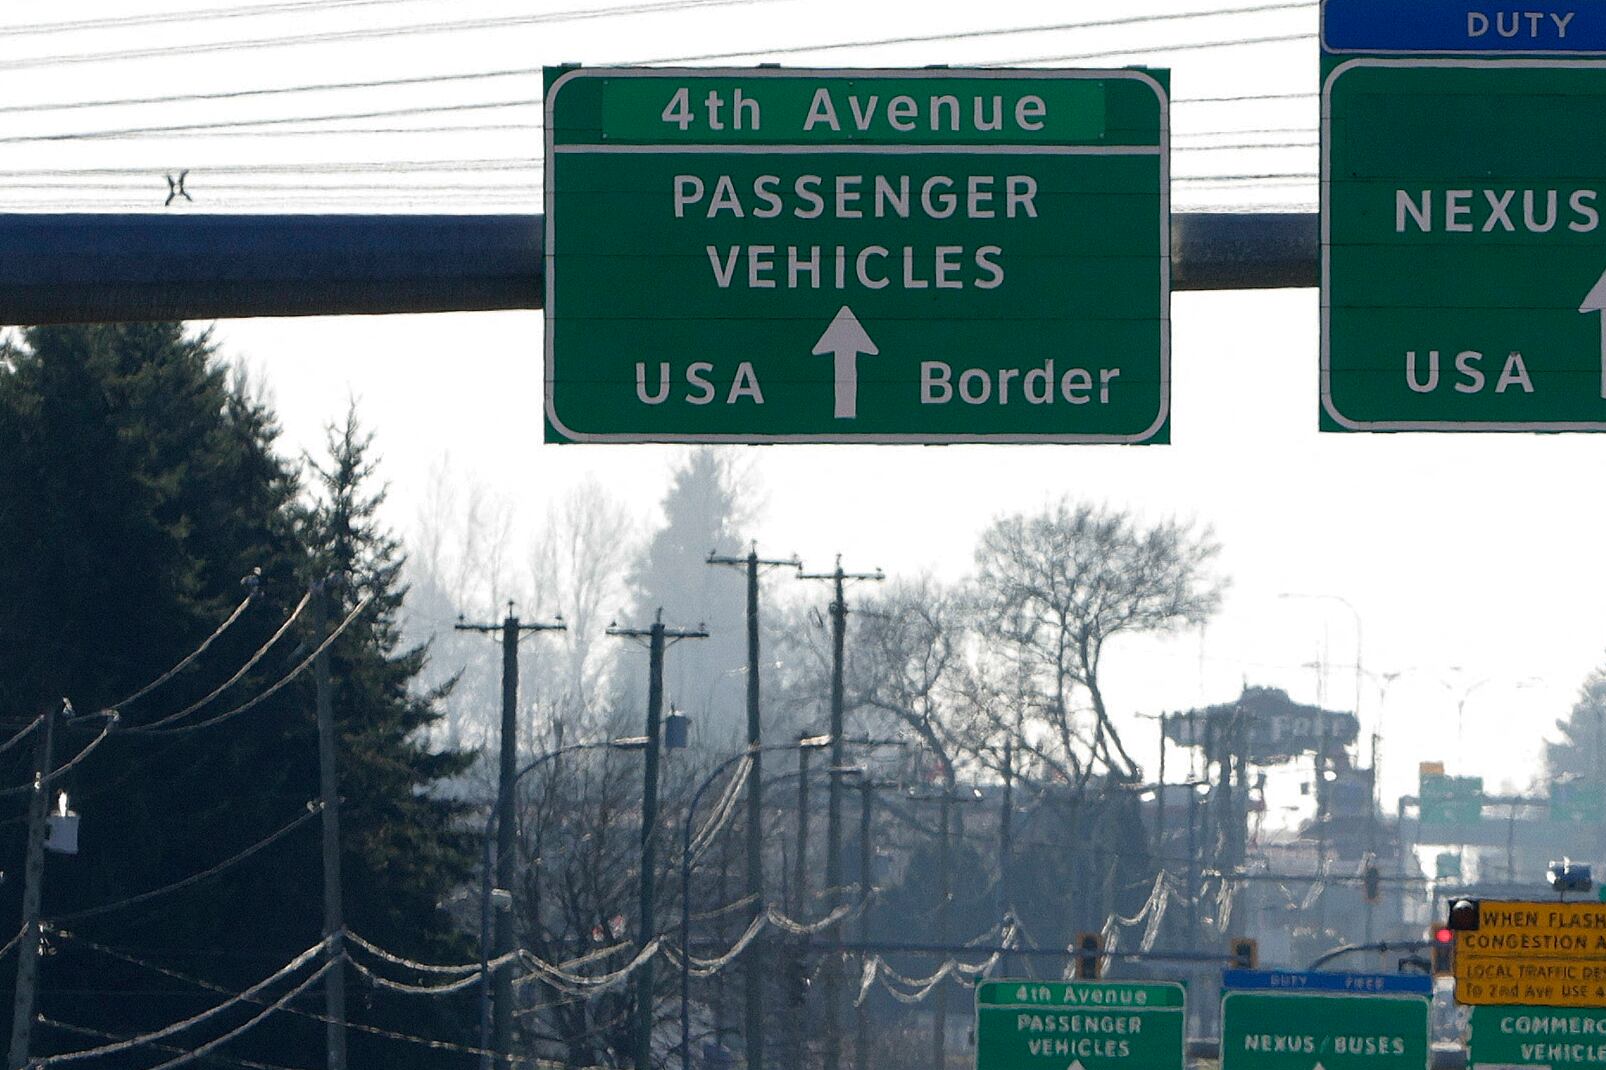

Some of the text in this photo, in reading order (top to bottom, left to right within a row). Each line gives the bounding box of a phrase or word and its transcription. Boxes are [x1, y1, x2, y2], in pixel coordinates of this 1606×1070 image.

[1466, 12, 1577, 38] DUTY
[661, 88, 1048, 132] 4th Avenue
[673, 174, 1038, 219] PASSENGER
[1395, 188, 1600, 234] NEXUS
[706, 245, 1005, 290] VEHICLES
[634, 358, 1121, 406] USA Border
[1405, 350, 1535, 394] USA
[1483, 912, 1537, 928] WHEN
[1465, 934, 1587, 950] CONGESTION
[1467, 965, 1513, 978] LOCAL
[1016, 985, 1147, 1005] 4th Avenue
[1561, 985, 1588, 998] USE
[1017, 1014, 1142, 1034] PASSENGER
[1028, 1038, 1130, 1058] VEHICLES
[1245, 1034, 1315, 1053] NEXUS
[1334, 1035, 1405, 1055] BUSES
